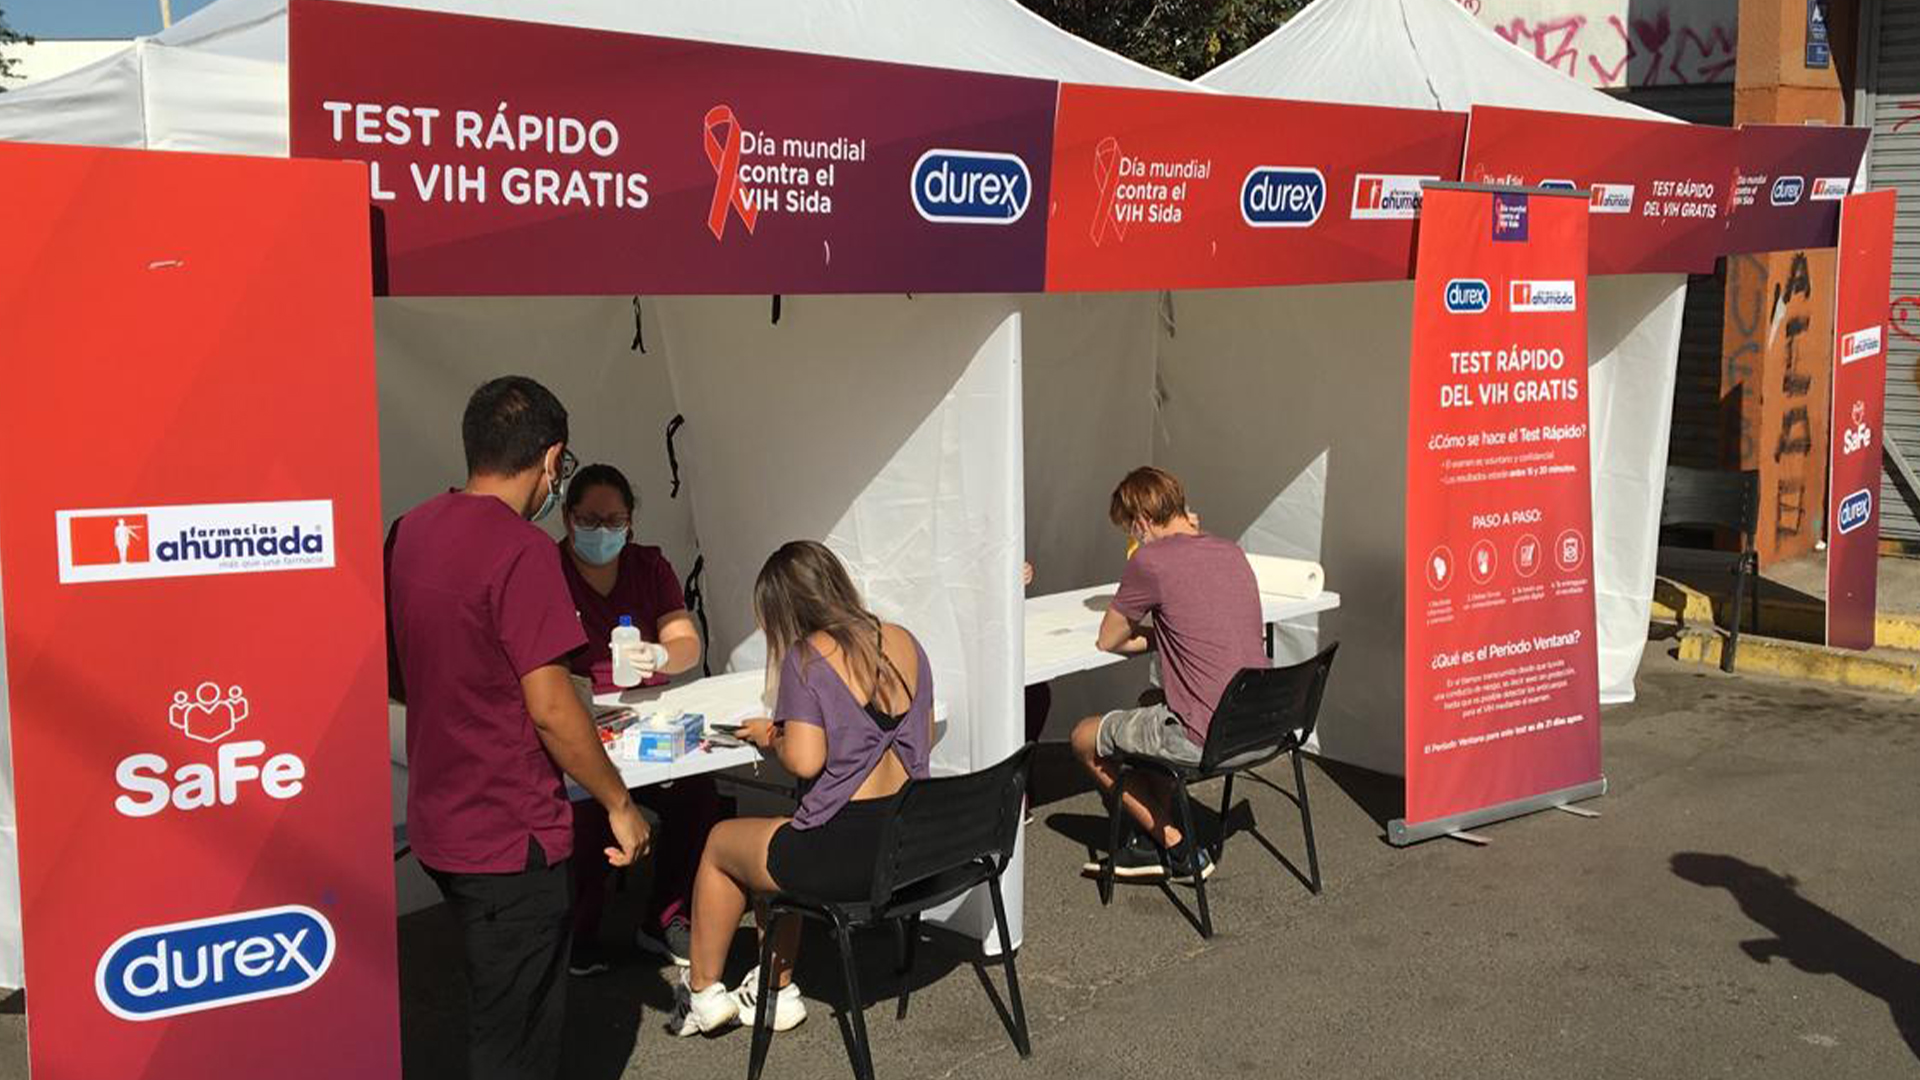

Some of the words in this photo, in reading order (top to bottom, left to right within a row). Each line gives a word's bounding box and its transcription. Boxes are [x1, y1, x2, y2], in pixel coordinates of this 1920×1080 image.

[323, 100, 440, 146] TEST
[456, 101, 619, 157] RÁPIDO
[739, 130, 776, 156] Día
[782, 138, 866, 162] mundial
[739, 163, 809, 187] contra
[815, 164, 835, 187] el
[1119, 156, 1146, 178] Día
[1150, 160, 1211, 180] mundial
[410, 162, 486, 203] VIH
[501, 167, 650, 209] GRATIS
[924, 161, 1020, 211] durex
[1116, 181, 1168, 201] contra
[1172, 181, 1186, 200] el
[1250, 175, 1319, 216] durex
[1652, 180, 1675, 197] TEST
[1675, 178, 1714, 199] RÁPIDO
[1773, 180, 1800, 199] durex
[739, 188, 779, 212] VIH
[785, 188, 832, 214] Sida
[1115, 204, 1142, 222] VIH
[1148, 204, 1182, 224] Sida
[1643, 201, 1660, 217] DEL
[1663, 202, 1681, 217] VIH
[1681, 202, 1717, 219] GRATIS
[1450, 284, 1486, 306] durex
[1450, 350, 1491, 374] TEST
[1496, 344, 1564, 372] RÁPIDO
[1440, 385, 1473, 408] DEL
[1479, 381, 1509, 405] VIH
[1513, 378, 1578, 403] GRATIS
[1428, 433, 1466, 450] ¿Cómo
[1467, 434, 1479, 446] se
[1481, 431, 1506, 446] hace
[1508, 429, 1518, 443] el
[1519, 427, 1540, 442] Test
[1542, 424, 1587, 443] Rápido?
[1843, 423, 1872, 455] SaFe
[1472, 514, 1500, 529] PASO
[1502, 514, 1510, 525] A
[1512, 509, 1542, 524] PASO:
[1840, 499, 1868, 525] durex
[156, 525, 323, 562] ahumada
[189, 524, 277, 538] farmacias
[1432, 651, 1460, 670] ¿Qué
[1462, 651, 1475, 663] es
[1477, 645, 1488, 660] el
[1533, 630, 1581, 651] Ventana?
[115, 740, 306, 817] SaFe
[122, 928, 316, 997] durex
